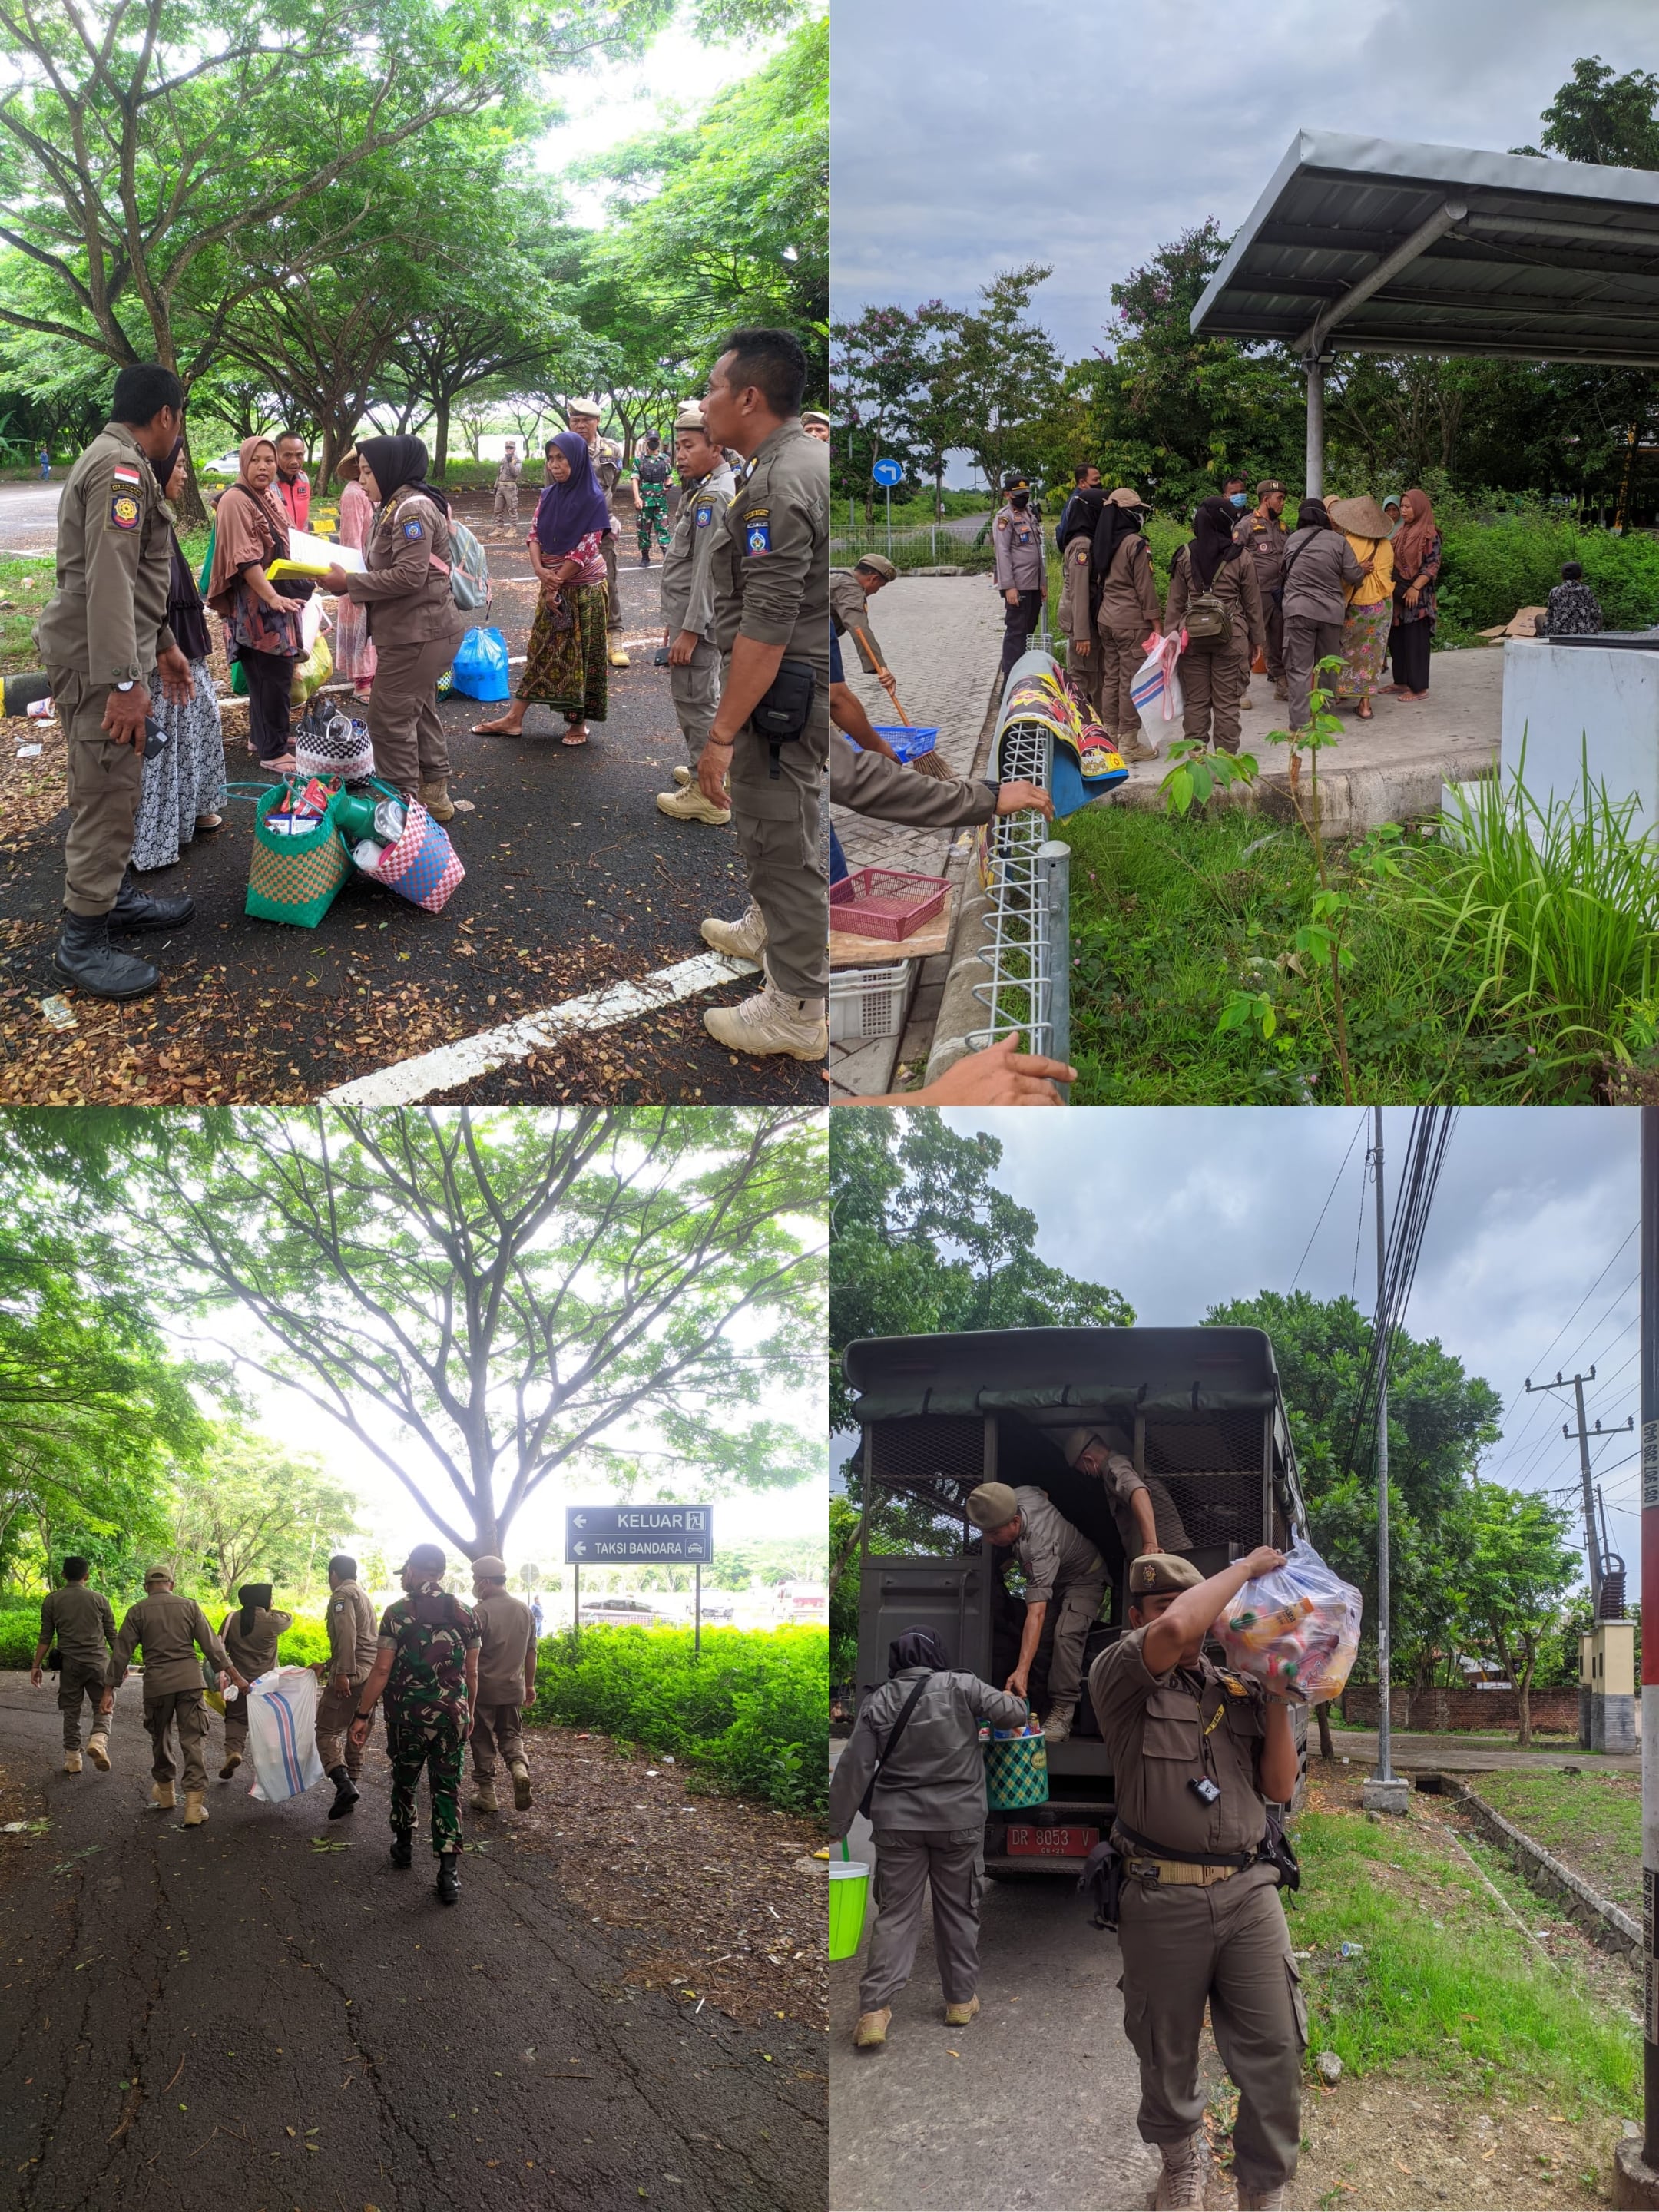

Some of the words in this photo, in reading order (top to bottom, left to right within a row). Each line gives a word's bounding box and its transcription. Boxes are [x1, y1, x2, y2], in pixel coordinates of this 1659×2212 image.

[1644, 1422, 1657, 1443] 048
[1644, 1444, 1658, 1464] 389
[1644, 1466, 1658, 1484] 907
[1644, 1485, 1658, 1503] 081
[618, 1514, 683, 1528] KELUAR
[594, 1542, 627, 1554] TAKSI
[629, 1542, 682, 1554] BANDARA
[1012, 1830, 1028, 1845] DR
[1036, 1830, 1068, 1846] 8053
[1081, 1830, 1089, 1846] V
